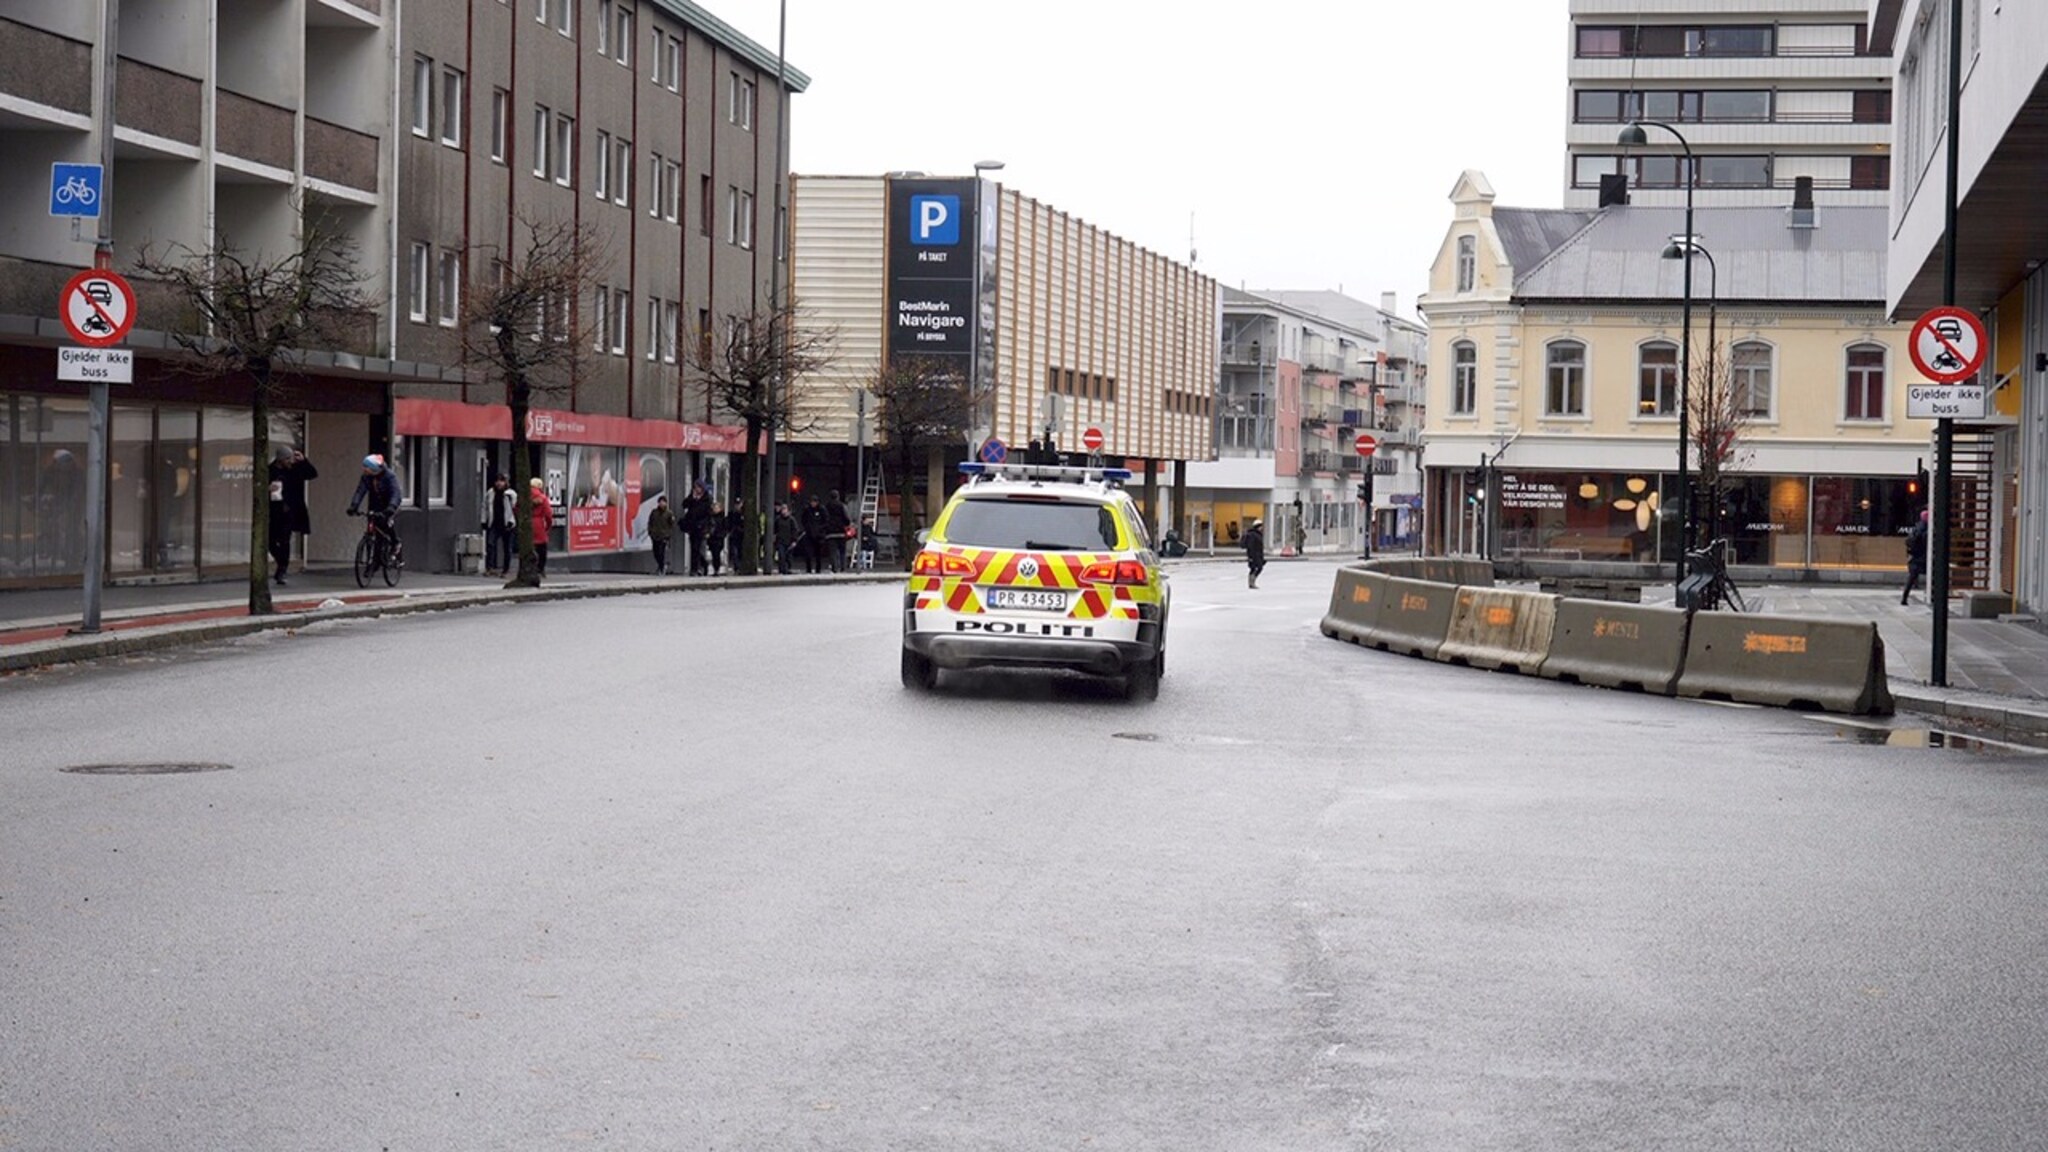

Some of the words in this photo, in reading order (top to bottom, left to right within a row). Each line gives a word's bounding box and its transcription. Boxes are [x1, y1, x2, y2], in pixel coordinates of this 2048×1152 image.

[921, 201, 947, 238] P
[899, 301, 950, 311] BestMarin
[899, 313, 965, 329] Navigare
[62, 350, 100, 364] Gjelder
[107, 352, 129, 364] ikke
[82, 366, 108, 377] buss
[1911, 388, 1951, 401] Gjelder
[1958, 388, 1982, 399] ikke
[1932, 403, 1960, 413] buss
[1520, 500, 1546, 508] DESIGN
[999, 592, 1015, 603] PR
[1021, 592, 1063, 607] 43453
[956, 621, 1093, 637] POLITI
